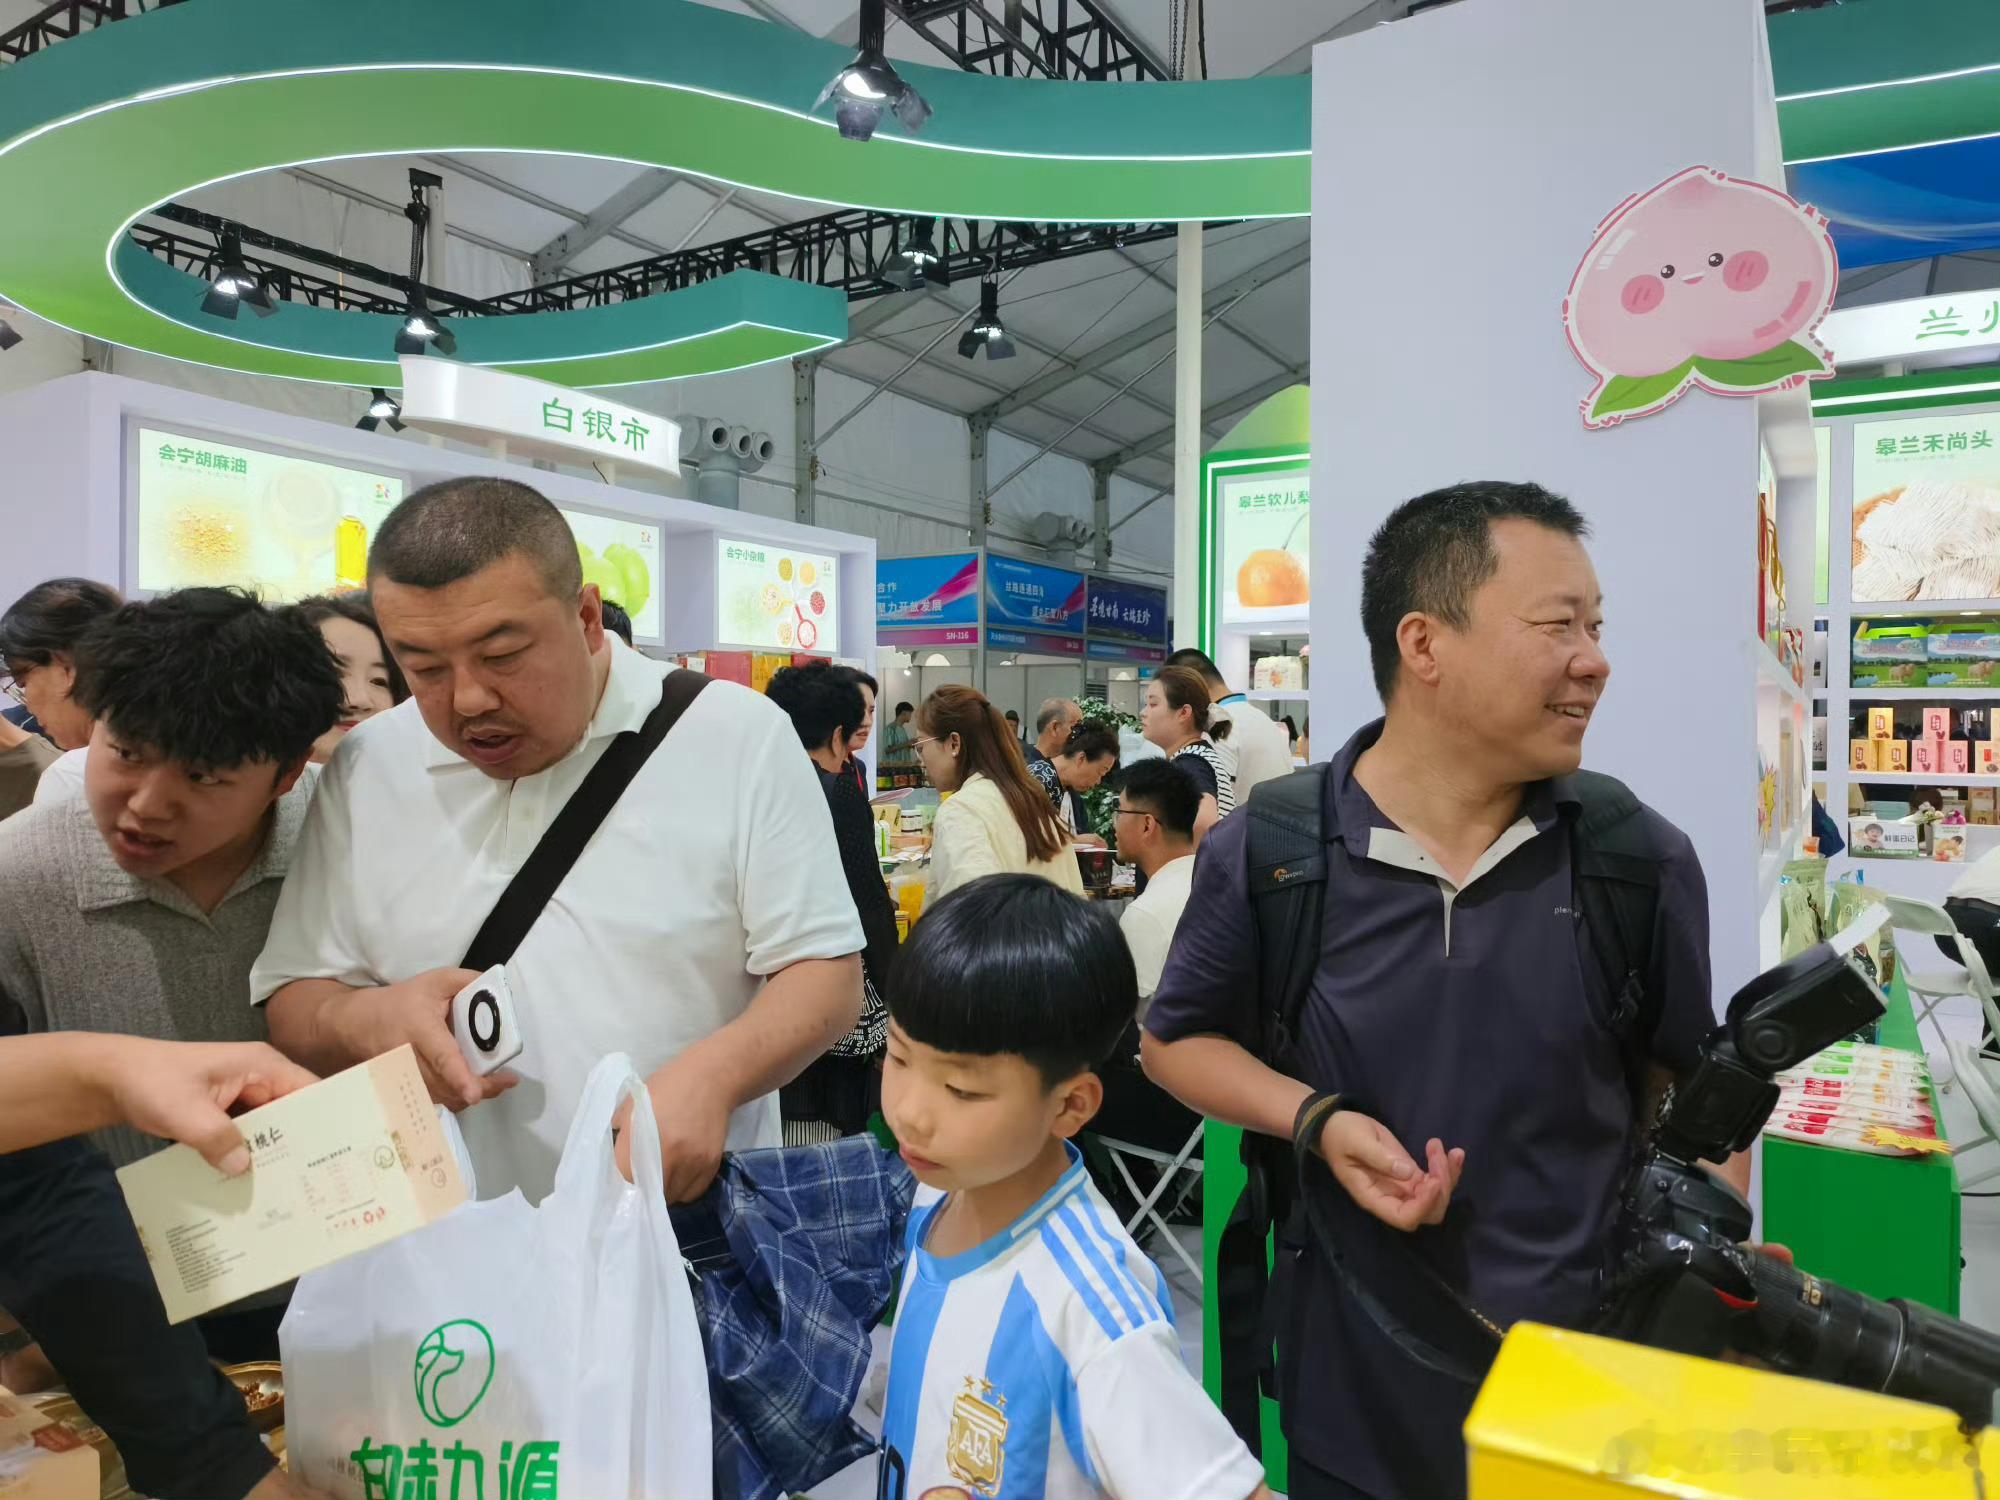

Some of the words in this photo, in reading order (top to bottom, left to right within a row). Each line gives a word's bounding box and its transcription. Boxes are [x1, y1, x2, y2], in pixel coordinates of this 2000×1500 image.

[542, 397, 650, 451] 白银市
[1875, 430, 1993, 457] 皋兰禾尚头
[159, 444, 248, 474] 会宁胡麻油
